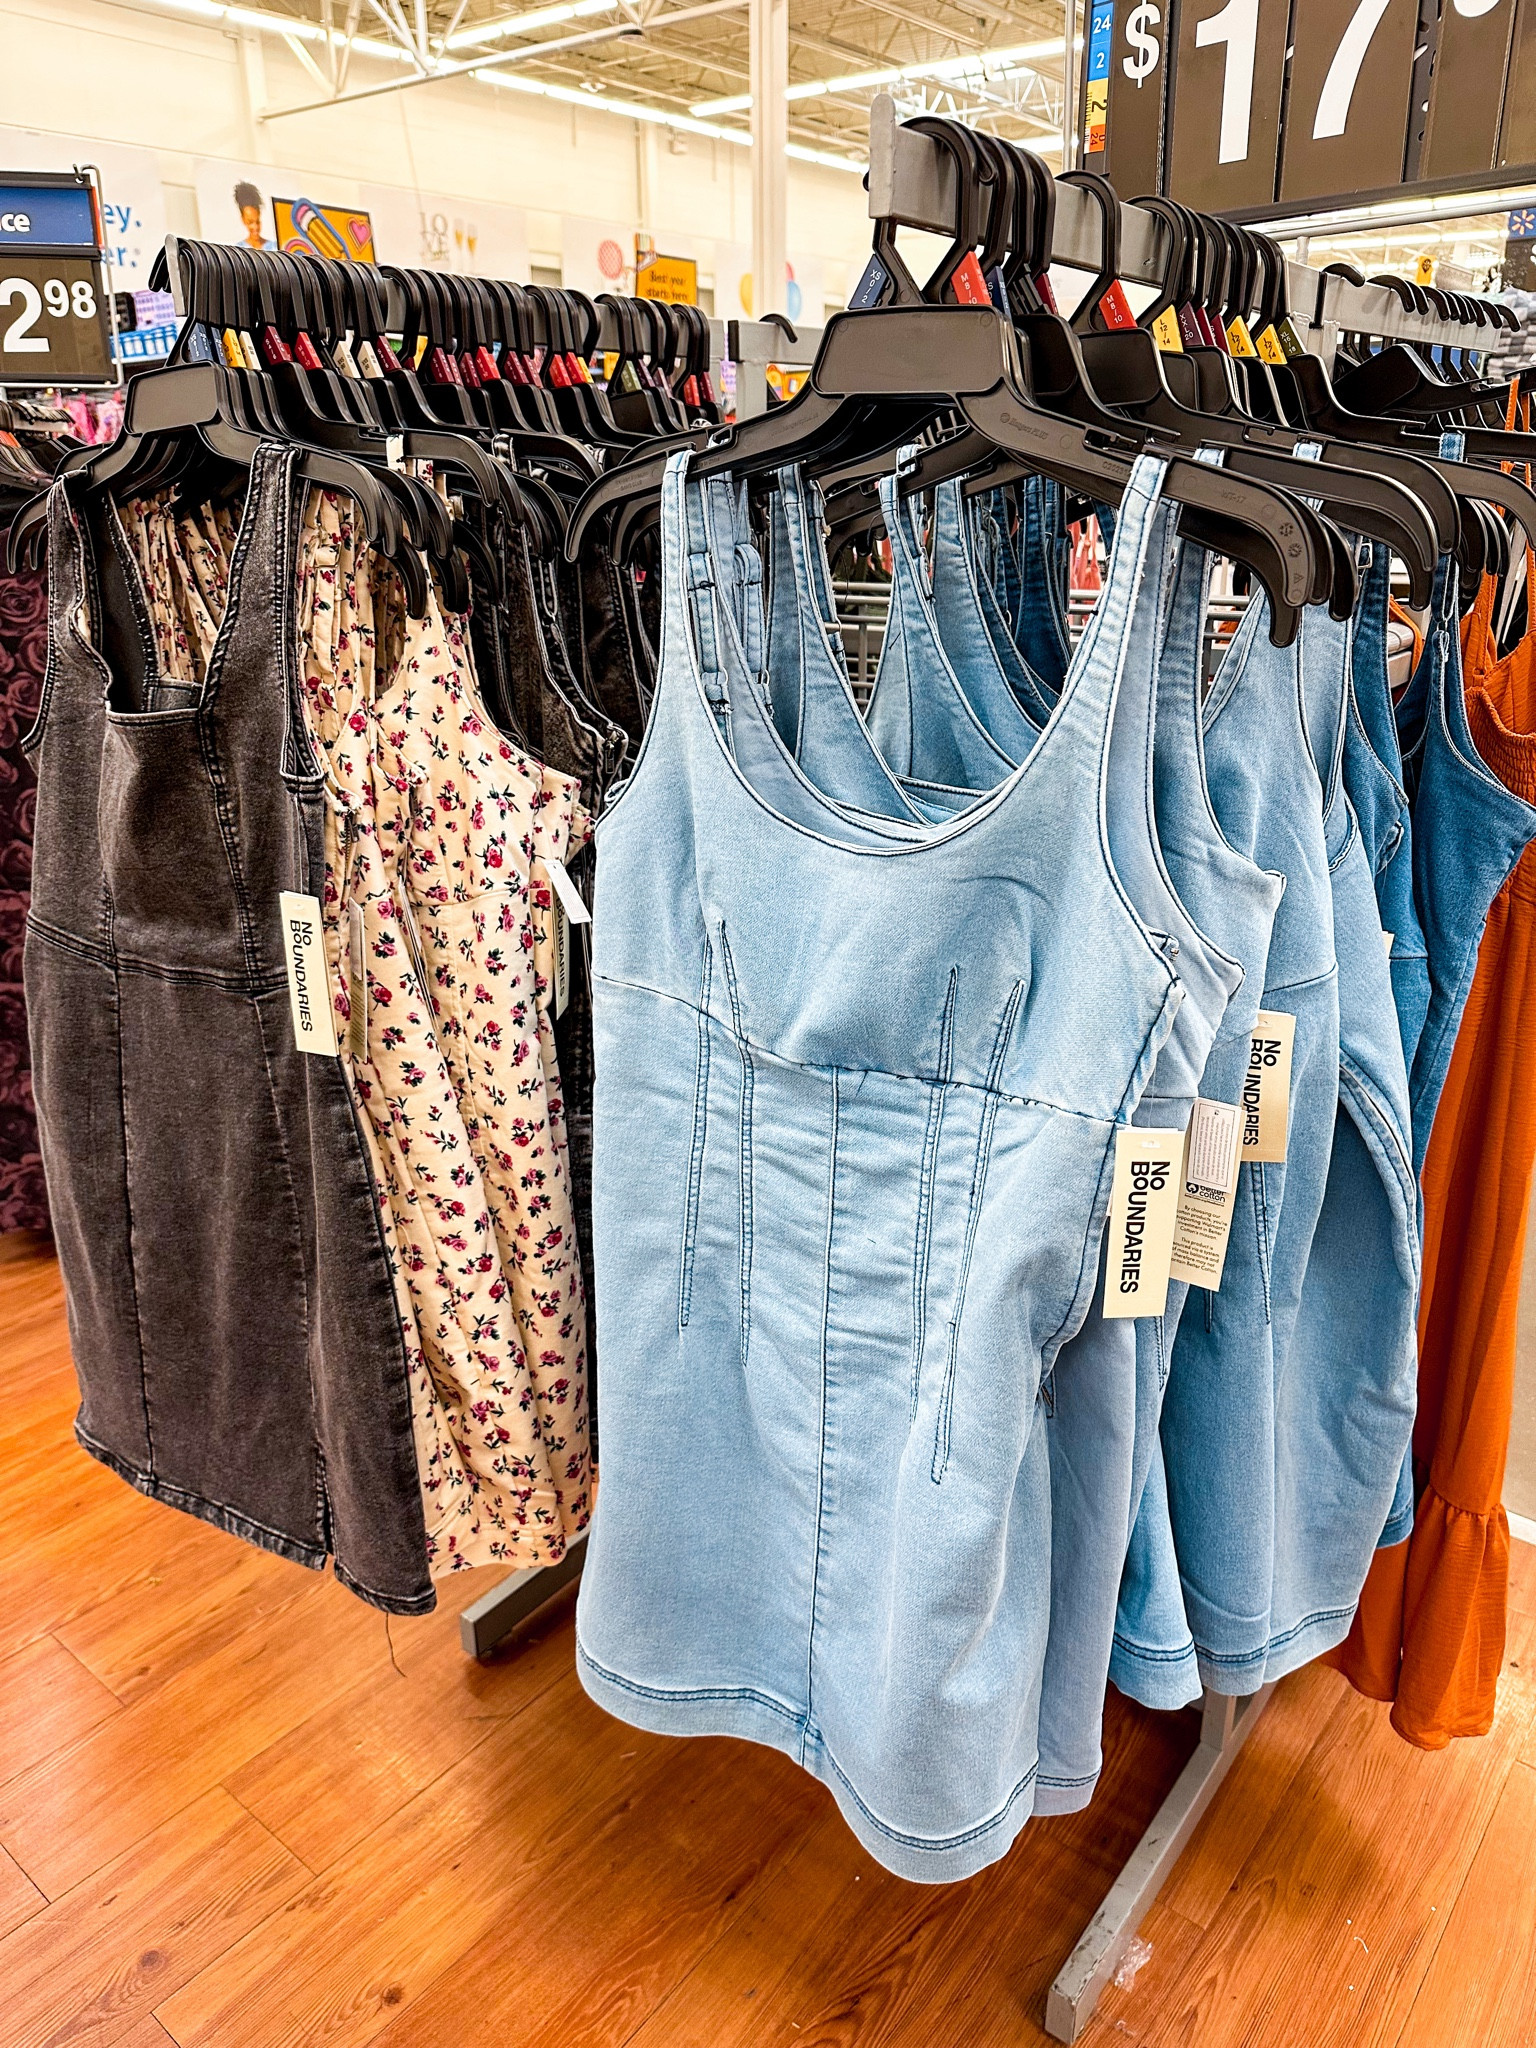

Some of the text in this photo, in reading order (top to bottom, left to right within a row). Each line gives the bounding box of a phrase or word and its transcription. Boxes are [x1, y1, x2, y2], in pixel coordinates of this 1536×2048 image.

[1093, 14, 1111, 35] 24
[1095, 52, 1105, 69] 2
[0, 212, 31, 233] ce
[290, 919, 313, 1032] BOUNDARIES
[1199, 1191, 1226, 1203] cotton
[1120, 1161, 1150, 1294] BOUNDARIES
